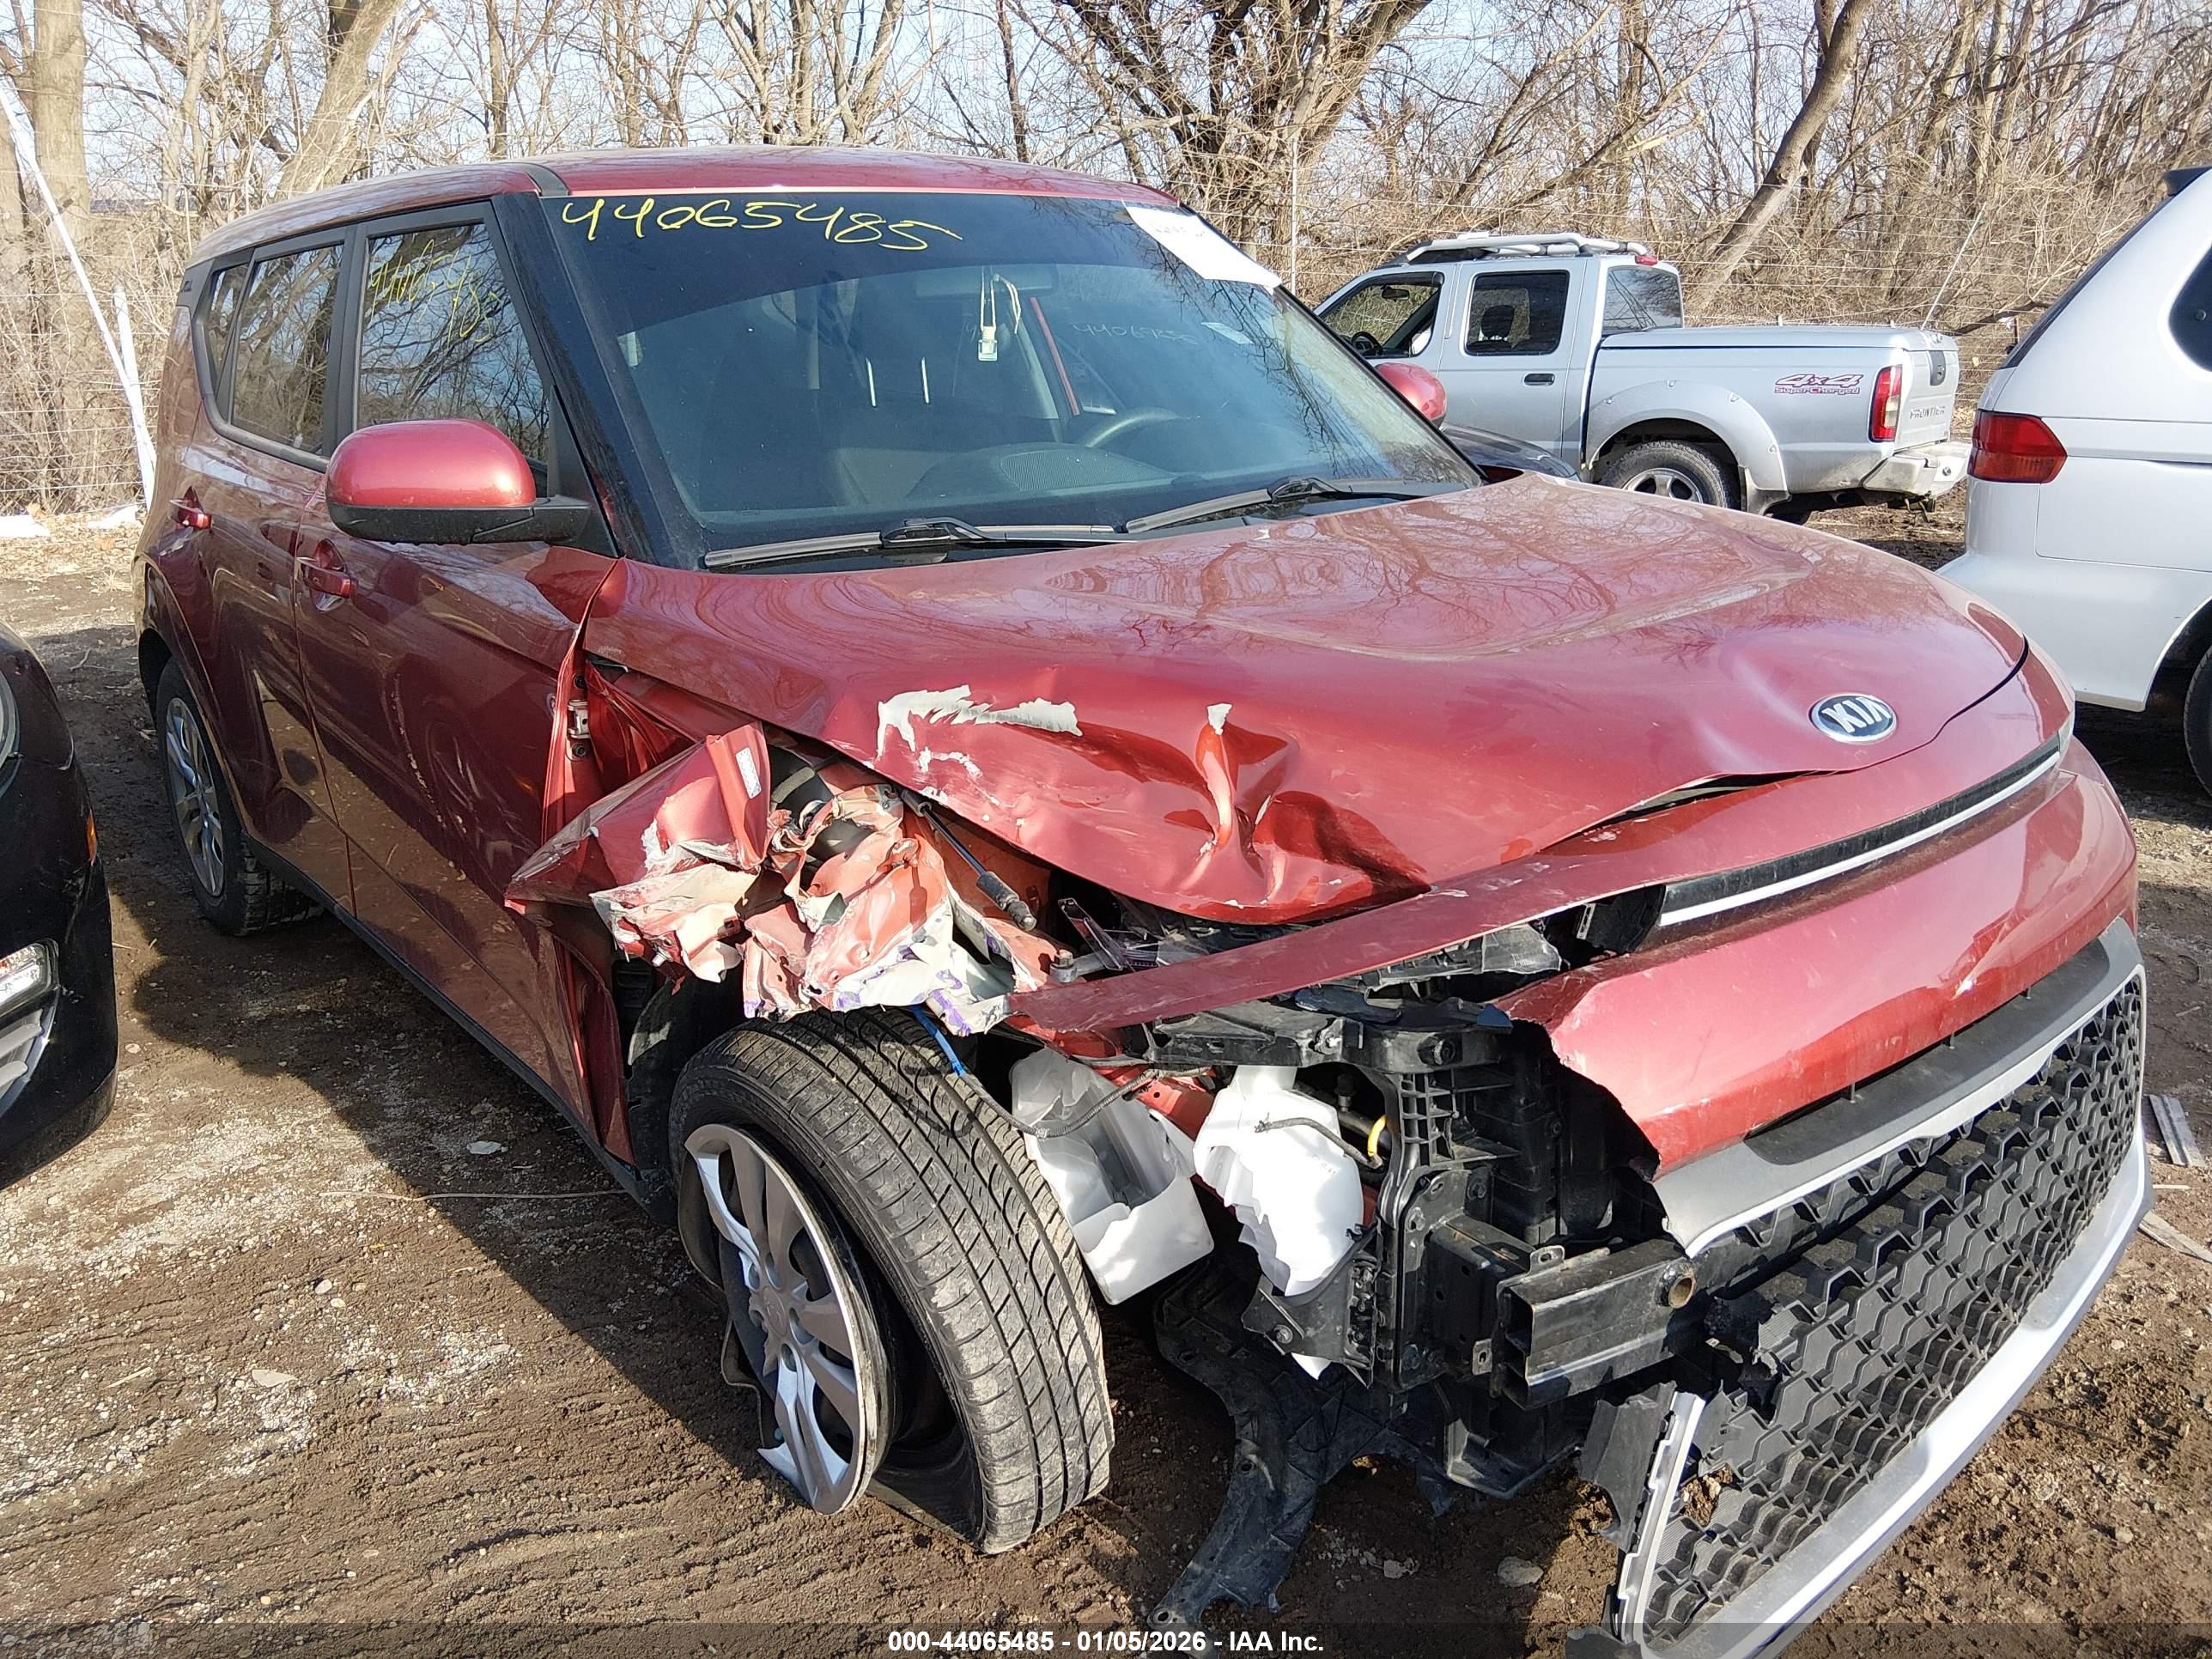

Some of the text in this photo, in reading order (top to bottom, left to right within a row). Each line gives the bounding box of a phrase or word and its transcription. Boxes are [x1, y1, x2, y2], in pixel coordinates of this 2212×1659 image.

[562, 198, 963, 251] 44065485
[1775, 373, 1864, 388] 4x4
[1821, 696, 1892, 733] KIA
